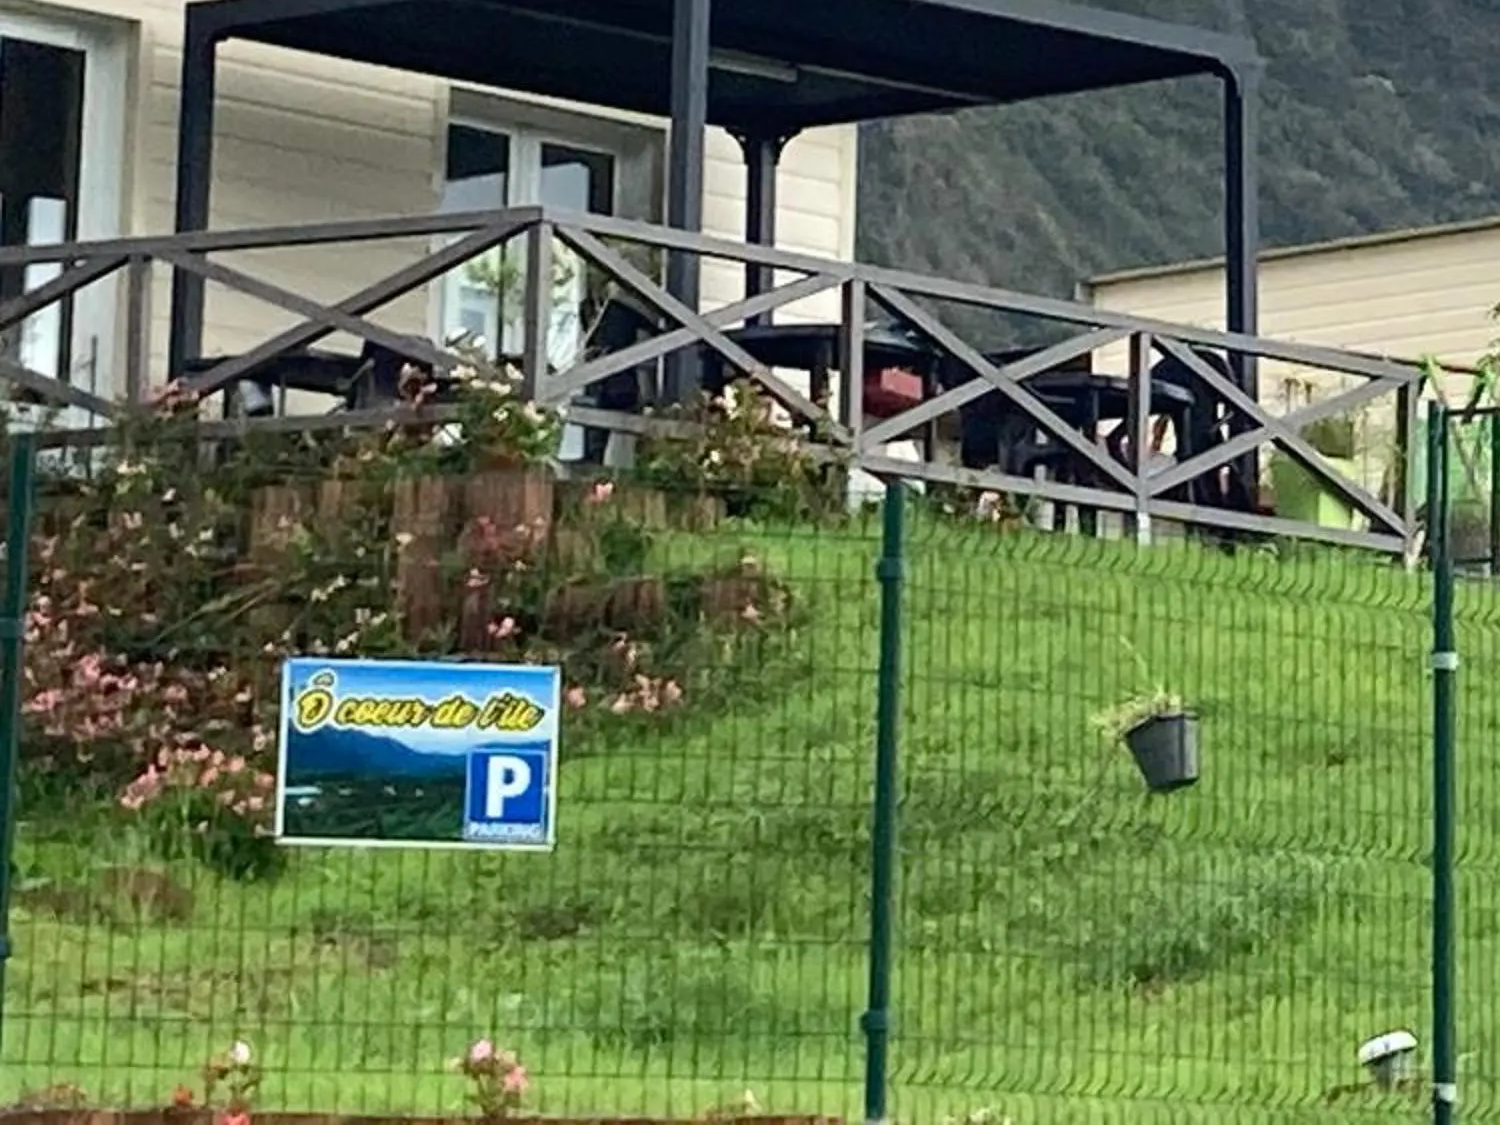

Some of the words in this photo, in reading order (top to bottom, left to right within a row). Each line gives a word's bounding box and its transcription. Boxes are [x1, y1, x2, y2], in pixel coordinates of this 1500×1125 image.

[297, 672, 334, 727] Ô
[430, 695, 477, 727] de
[486, 756, 531, 818] P
